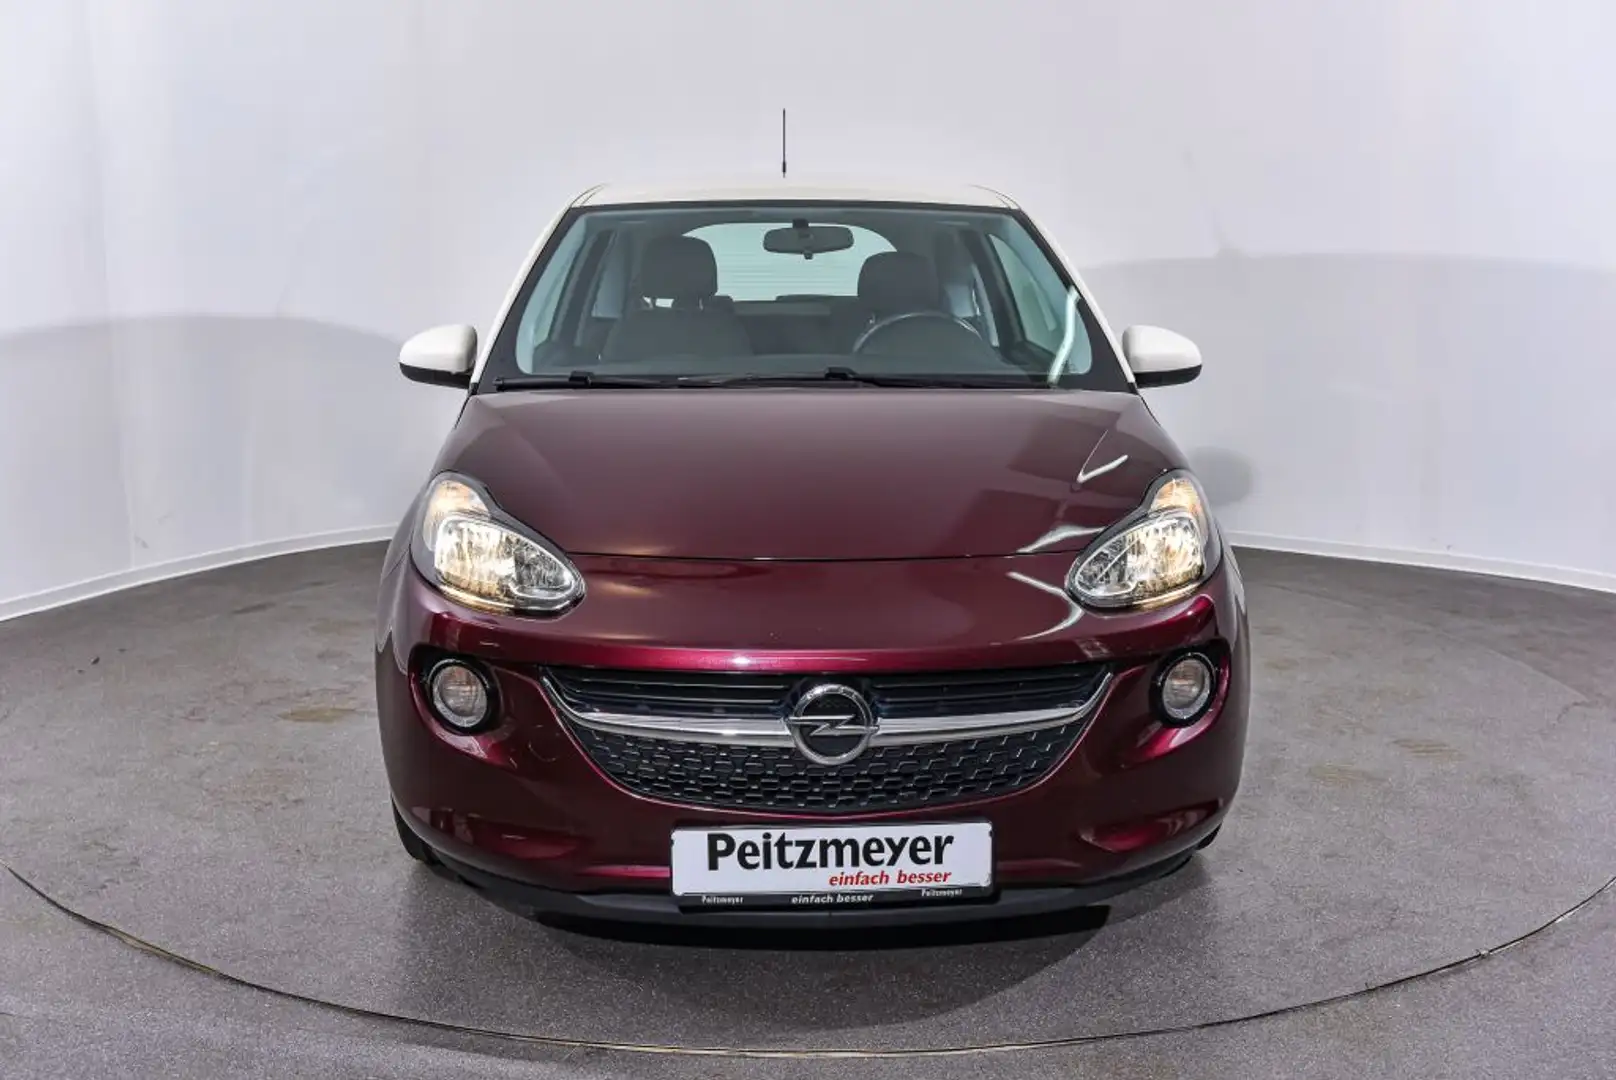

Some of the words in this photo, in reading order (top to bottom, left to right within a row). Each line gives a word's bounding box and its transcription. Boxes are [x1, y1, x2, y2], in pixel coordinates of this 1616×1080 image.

[707, 832, 954, 871] Peitzmeyer
[828, 870, 890, 886] einfach
[896, 869, 952, 884] besser
[791, 894, 833, 904] einfach
[836, 892, 874, 903] besser
